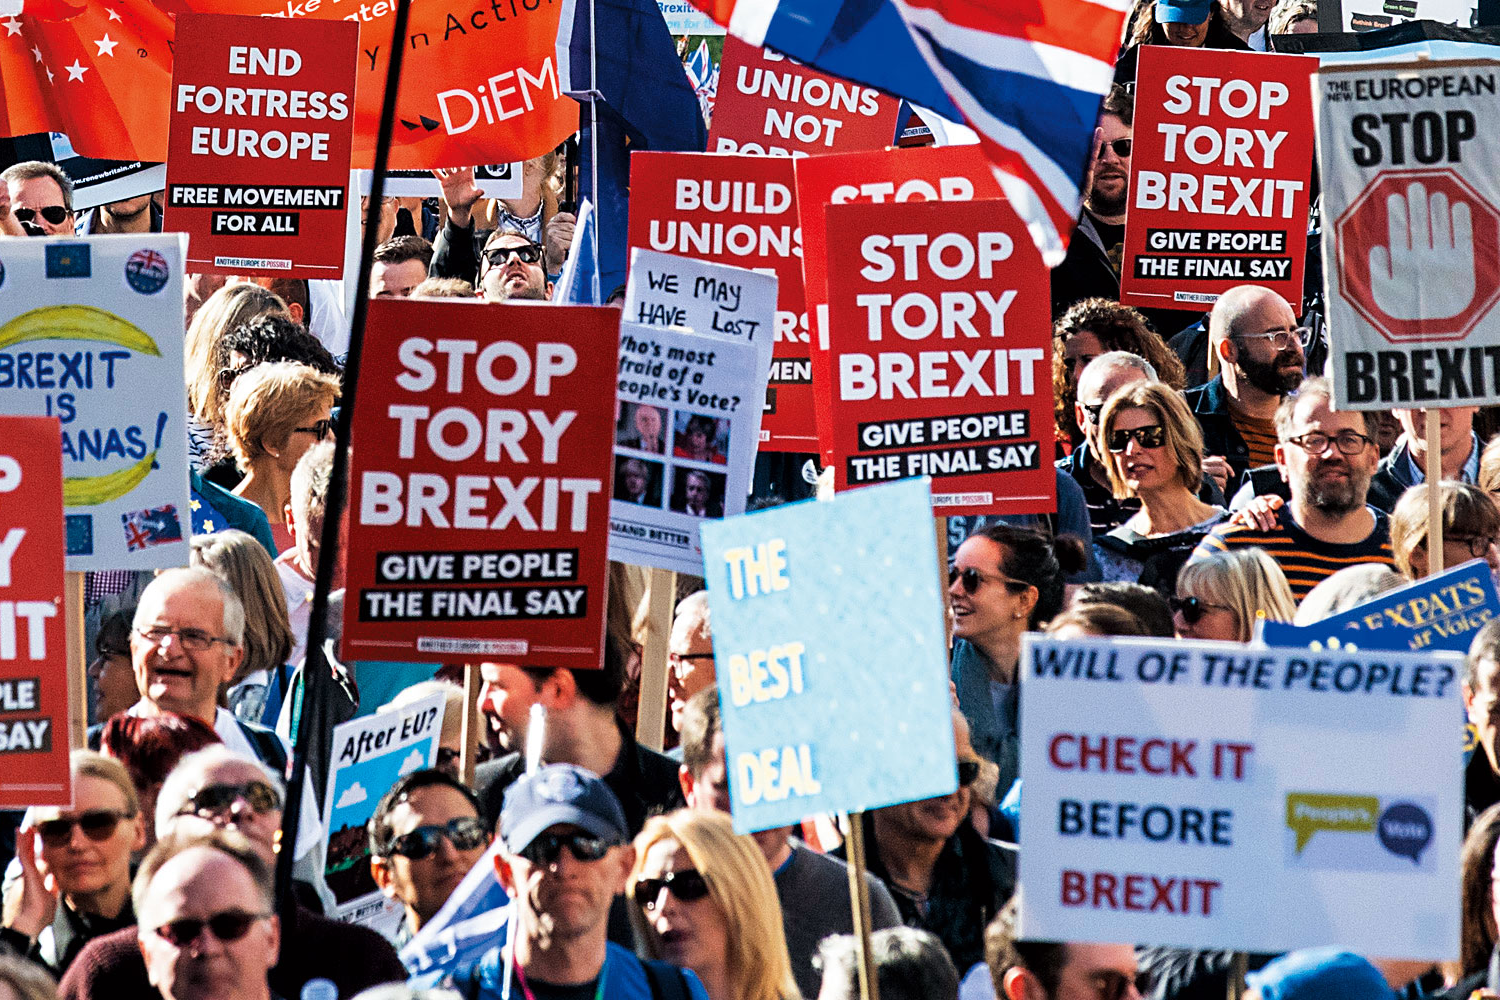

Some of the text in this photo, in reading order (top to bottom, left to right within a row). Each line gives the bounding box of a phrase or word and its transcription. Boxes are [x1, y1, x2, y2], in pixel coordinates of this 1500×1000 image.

[228, 47, 301, 76] END
[175, 85, 349, 122] FORTRESS
[434, 56, 559, 136] DiEM
[737, 66, 879, 117] UNIONS
[1163, 74, 1289, 120] STOP
[1327, 73, 1496, 101] THE EUROPEAN
[1327, 91, 1352, 103] NEW
[191, 126, 330, 161] EUROPE
[764, 108, 842, 148] NOT
[1157, 124, 1289, 169] TORY
[1352, 111, 1477, 166] STOP
[173, 187, 342, 207] FREE MOVEMENT
[1135, 171, 1303, 219] BREXIT
[216, 215, 295, 233] FOR ALL
[1150, 232, 1283, 252] GIVE PEOPLE
[267, 260, 291, 269] POSSIBLE
[860, 231, 1015, 283] STOP
[1140, 258, 1290, 279] THE FINAL SAY
[648, 271, 742, 312] WE MAY
[857, 290, 1018, 341] TORY
[638, 302, 759, 341] HAVE LOST
[395, 337, 578, 397] STOP
[839, 348, 1045, 401] BREXIT
[1346, 346, 1500, 402] BREXIT
[388, 405, 578, 464] TORY
[359, 470, 601, 532] BREXIT
[725, 538, 791, 600] THE
[730, 641, 805, 709] BEST
[1033, 645, 1456, 698] WILL OF THE PEOPLE?
[340, 709, 437, 764] After EU?
[1048, 734, 1256, 781] CHECK IT
[736, 744, 821, 807] DEAL
[1058, 799, 1234, 848] BEFORE
[1061, 869, 1222, 917] BREXIT
